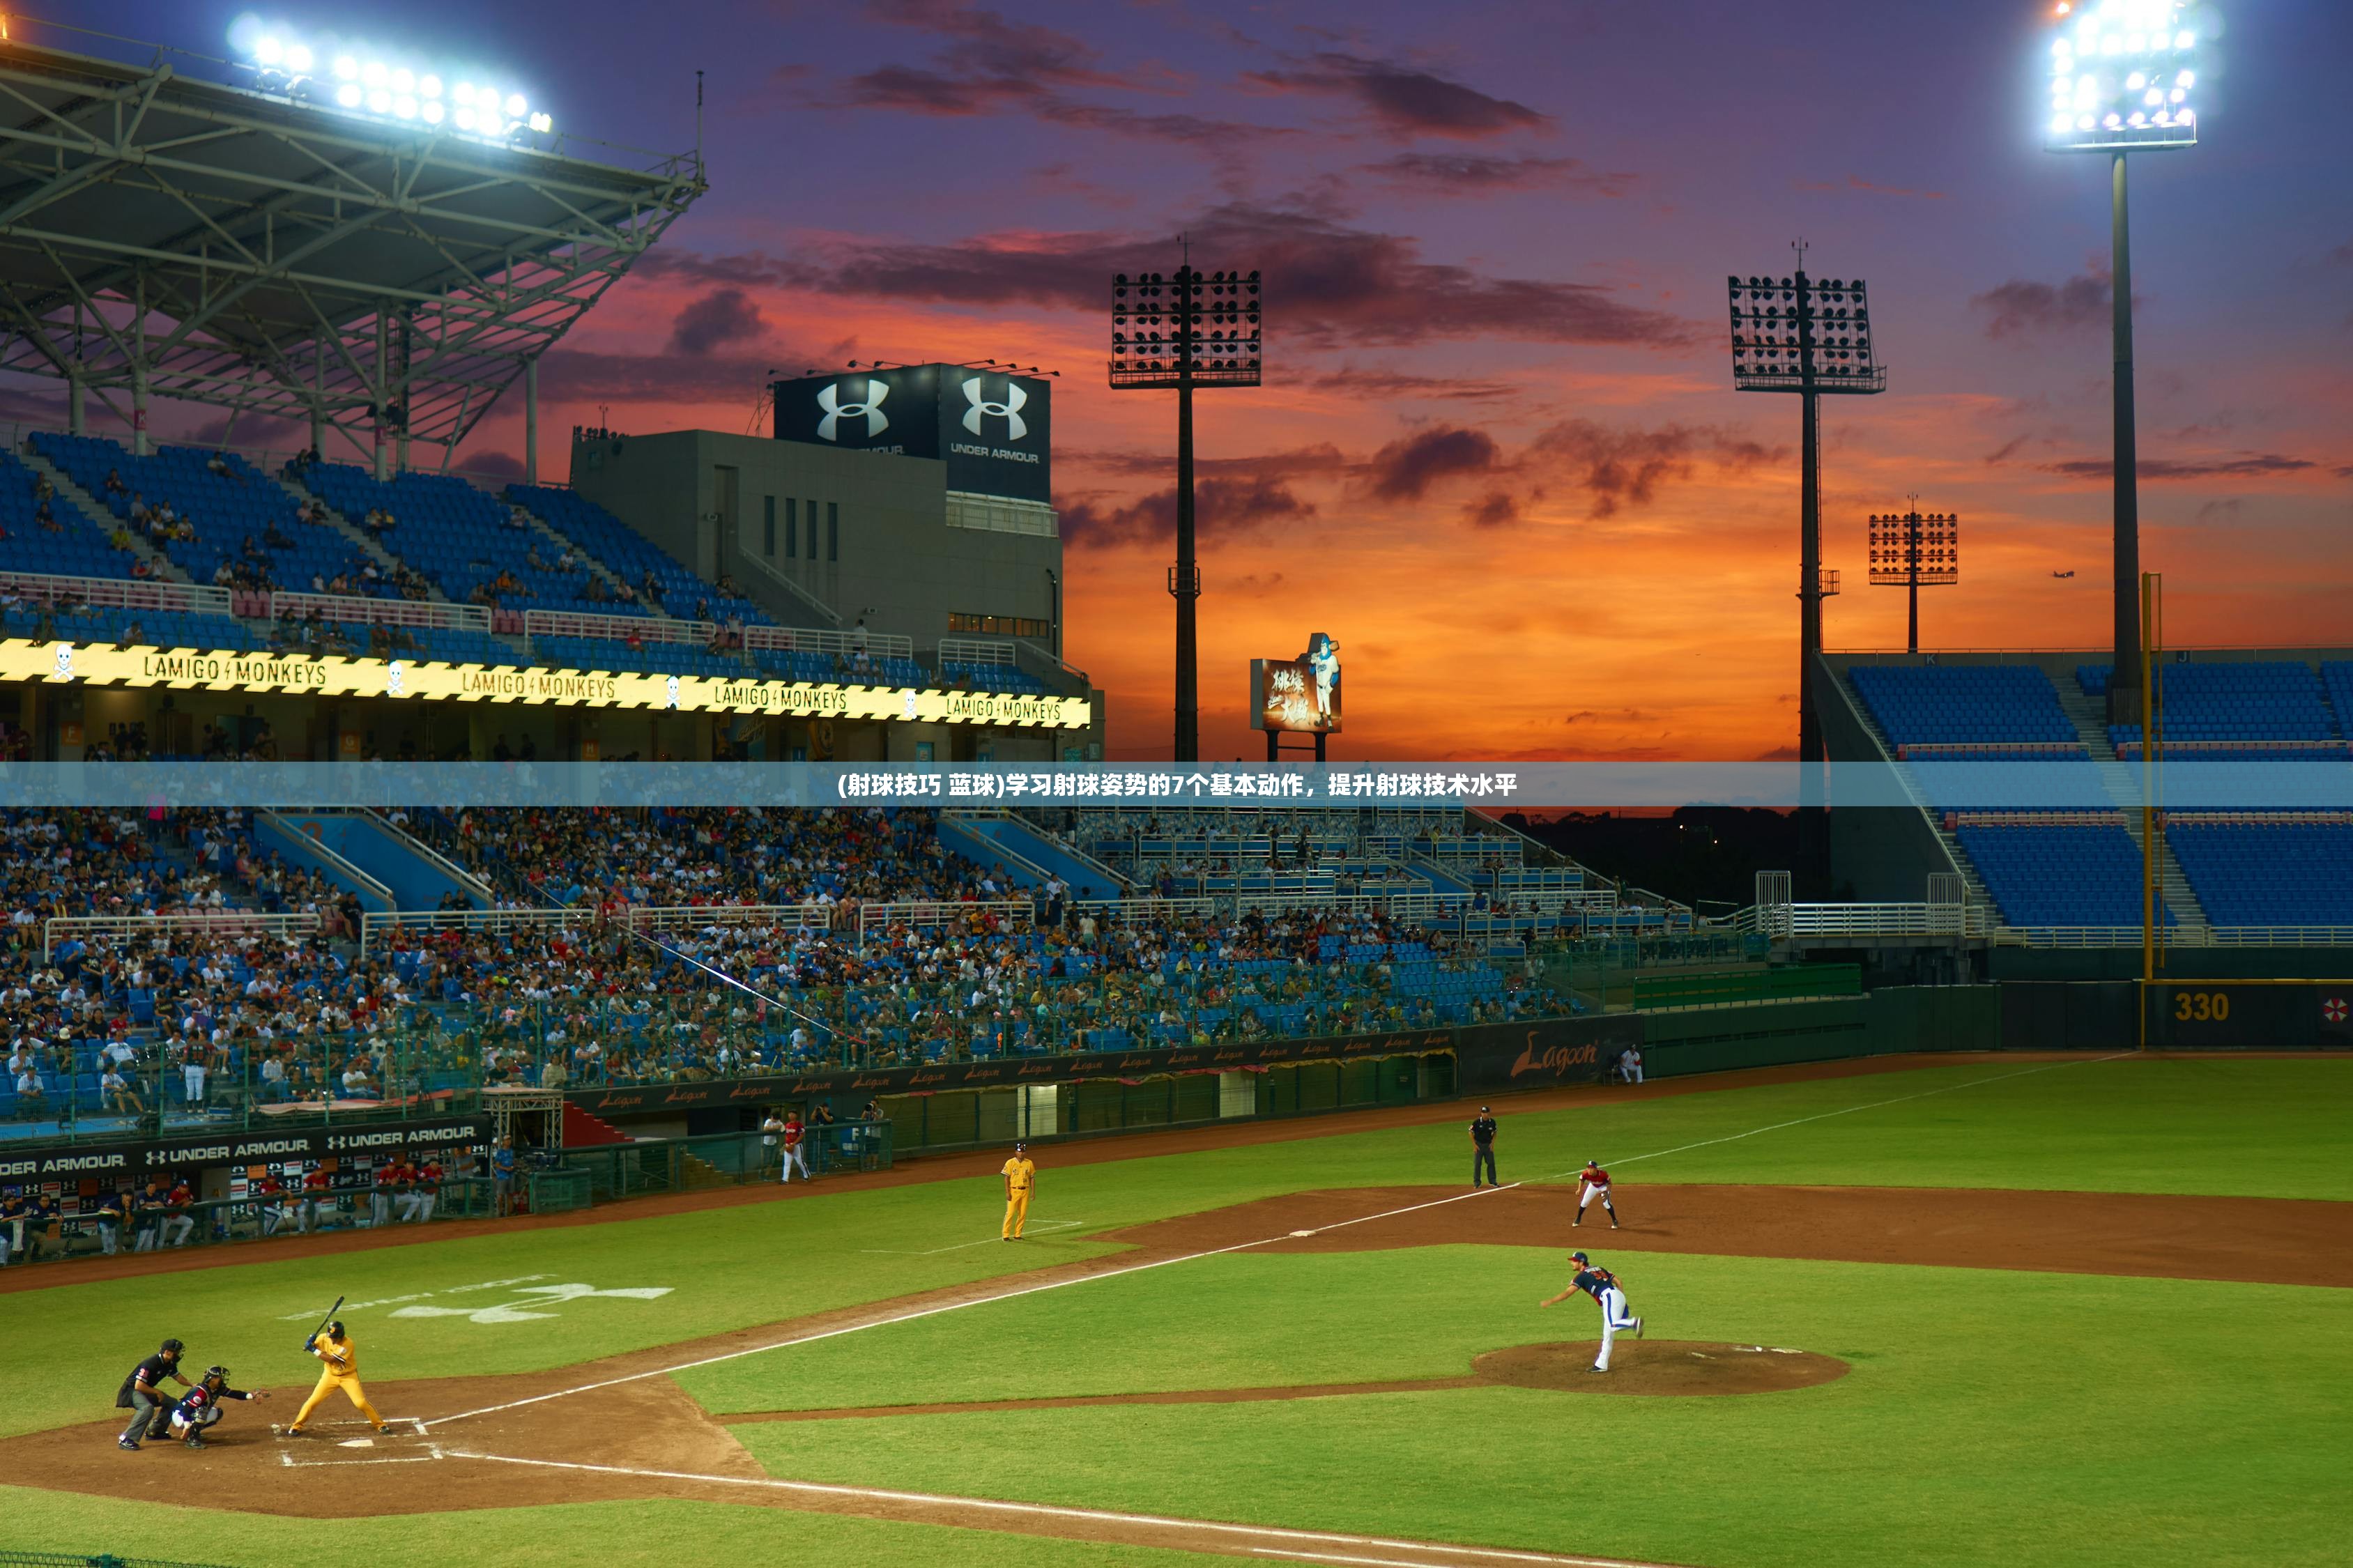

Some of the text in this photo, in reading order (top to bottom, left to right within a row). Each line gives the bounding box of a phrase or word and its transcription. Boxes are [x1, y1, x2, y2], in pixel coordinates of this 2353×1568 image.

[951, 443, 1039, 463] UNDER ARMOUR
[144, 656, 326, 684] LAMIGO MONKEYS
[463, 672, 615, 698] LAMIGO MONKEYS
[715, 686, 846, 709] LAMIGO MONKEYS
[947, 698, 1059, 720] LAMIGO MONKEYS
[68, 725, 76, 739] F
[345, 735, 354, 748] G
[586, 742, 594, 753] H
[2175, 992, 2229, 1021] 330
[1510, 1031, 1597, 1077] Lagoon
[348, 1126, 475, 1148] UNDER ARMOUR
[169, 1139, 308, 1162] UNDER ARMOUR
[42, 1155, 124, 1172] ARMOUR
